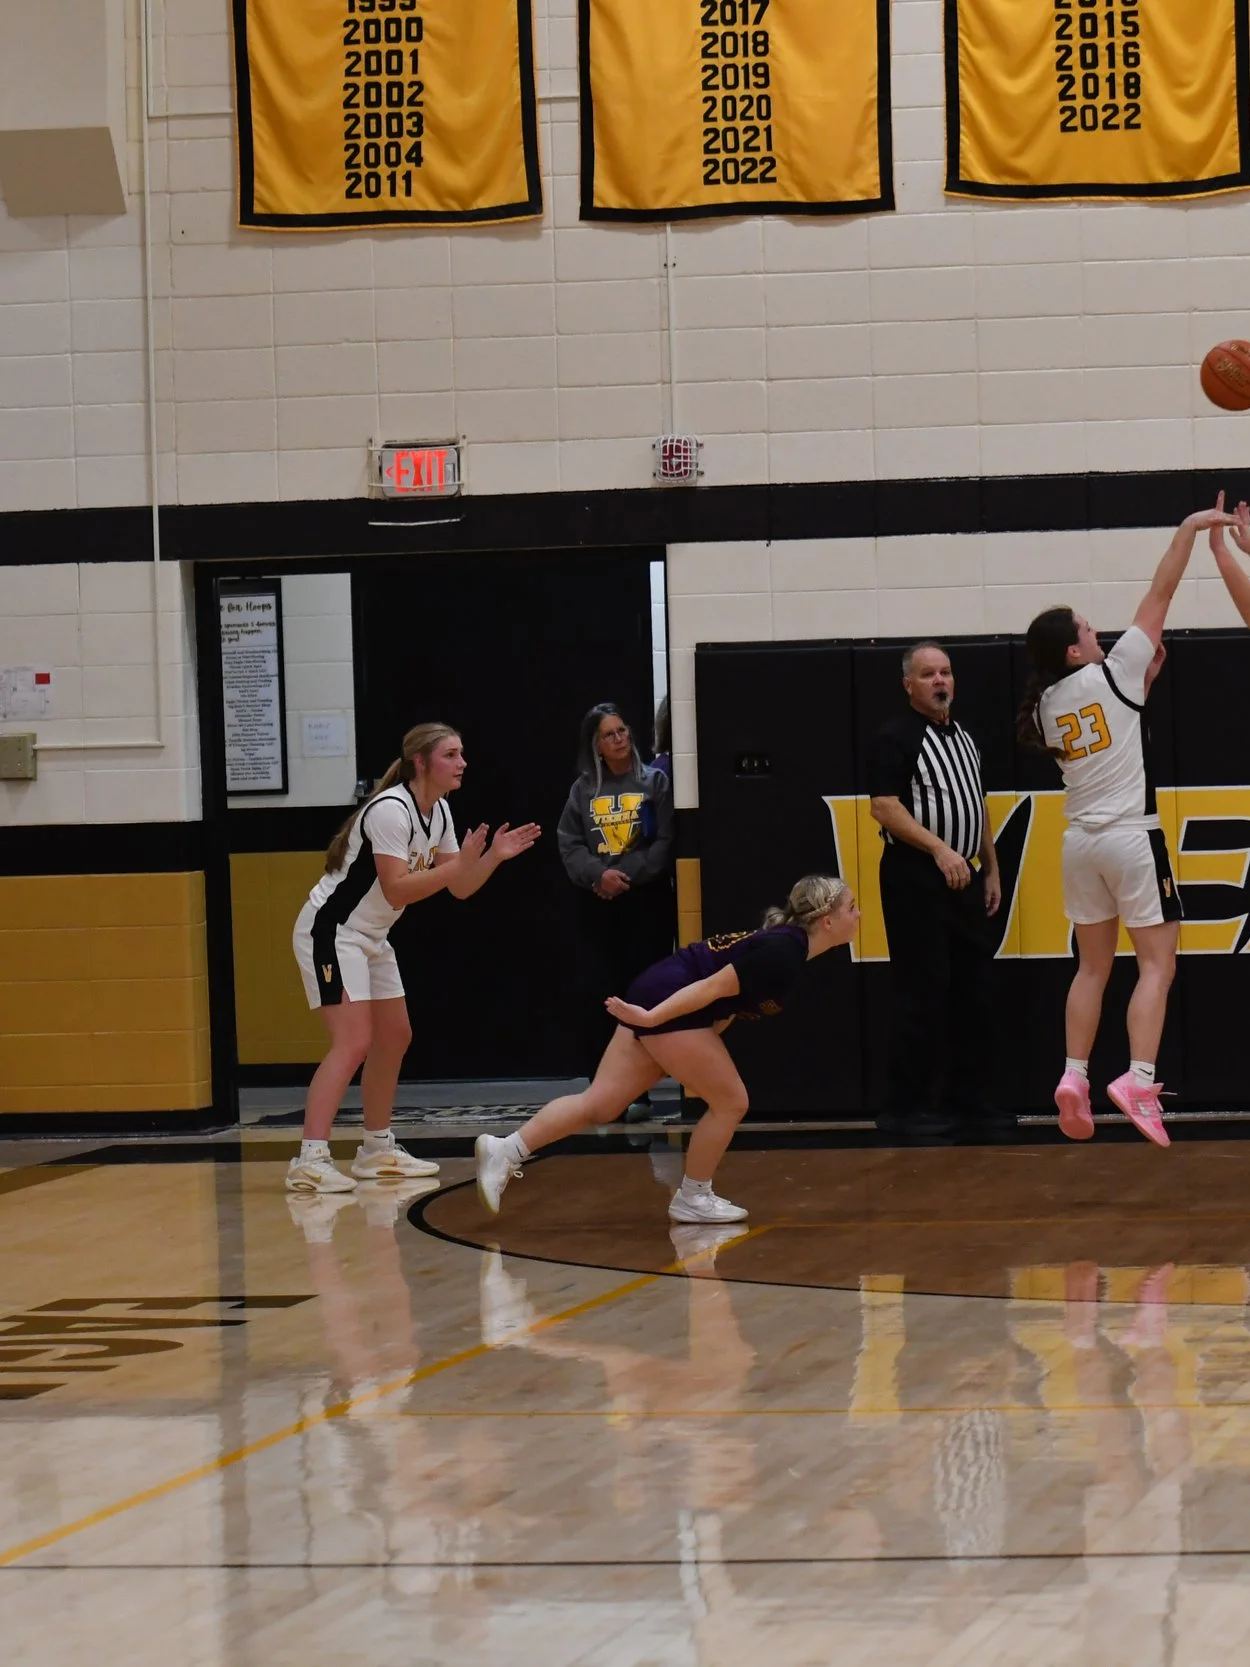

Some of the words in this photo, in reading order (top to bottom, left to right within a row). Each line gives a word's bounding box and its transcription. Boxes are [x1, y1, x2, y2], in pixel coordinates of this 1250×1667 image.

[700, 0, 770, 26] 2017
[1055, 10, 1140, 40] 2015
[343, 16, 423, 46] 2000
[701, 30, 769, 59] 2018
[344, 48, 419, 77] 2001
[1055, 41, 1141, 71] 2016
[701, 62, 770, 91] 2019
[1056, 71, 1141, 102] 2018
[343, 80, 424, 109] 2002
[702, 94, 771, 123] 2020
[343, 111, 424, 140] 2003
[1059, 102, 1142, 133] 2022
[702, 124, 773, 155] 2021
[343, 141, 424, 170] 2004
[345, 170, 412, 199] 2011
[702, 156, 777, 186] 2022
[394, 449, 448, 493] EXIT
[1055, 702, 1112, 762] 23
